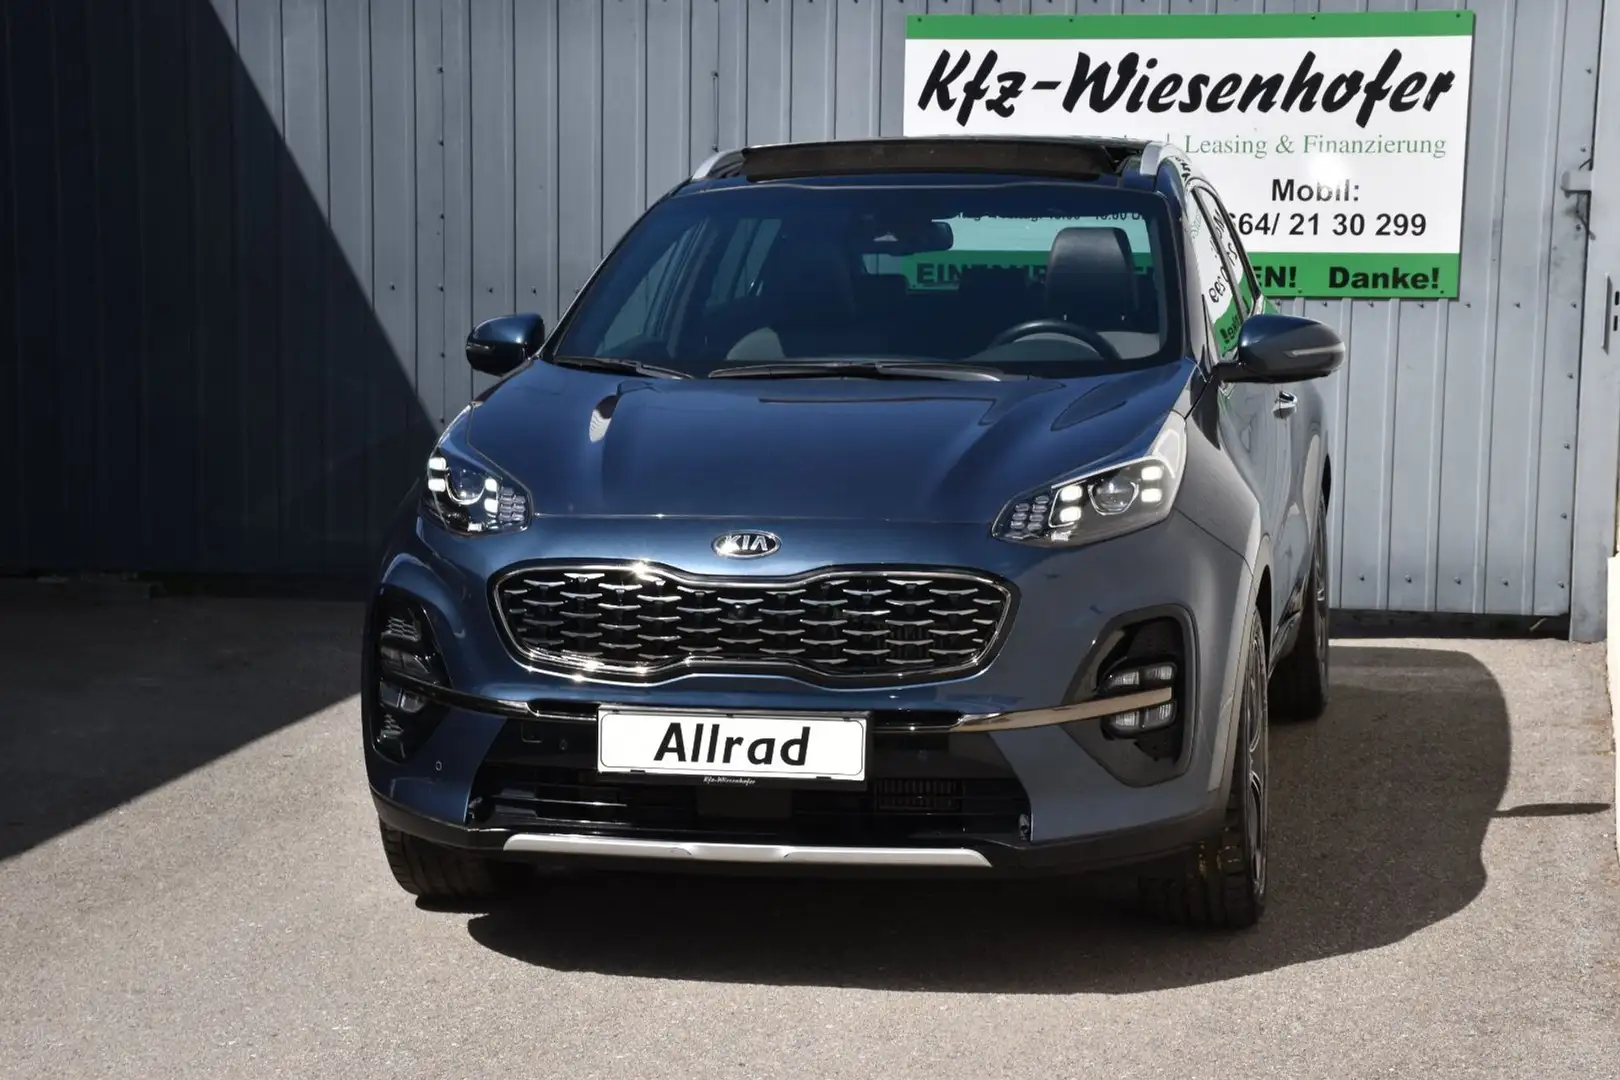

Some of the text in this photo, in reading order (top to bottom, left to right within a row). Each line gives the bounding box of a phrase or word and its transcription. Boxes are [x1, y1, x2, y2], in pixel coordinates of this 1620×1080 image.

[917, 49, 1455, 127] Kfz-Wiesenhofer
[1185, 133, 1448, 159] Leasing & Finanzierung
[1271, 178, 1360, 202] Mobil:
[1289, 213, 1320, 236] 21
[1332, 213, 1366, 236] 30
[1375, 213, 1427, 236] 299
[1328, 267, 1440, 289] Danke!
[724, 534, 768, 551] KIA
[653, 722, 811, 766] Allrad
